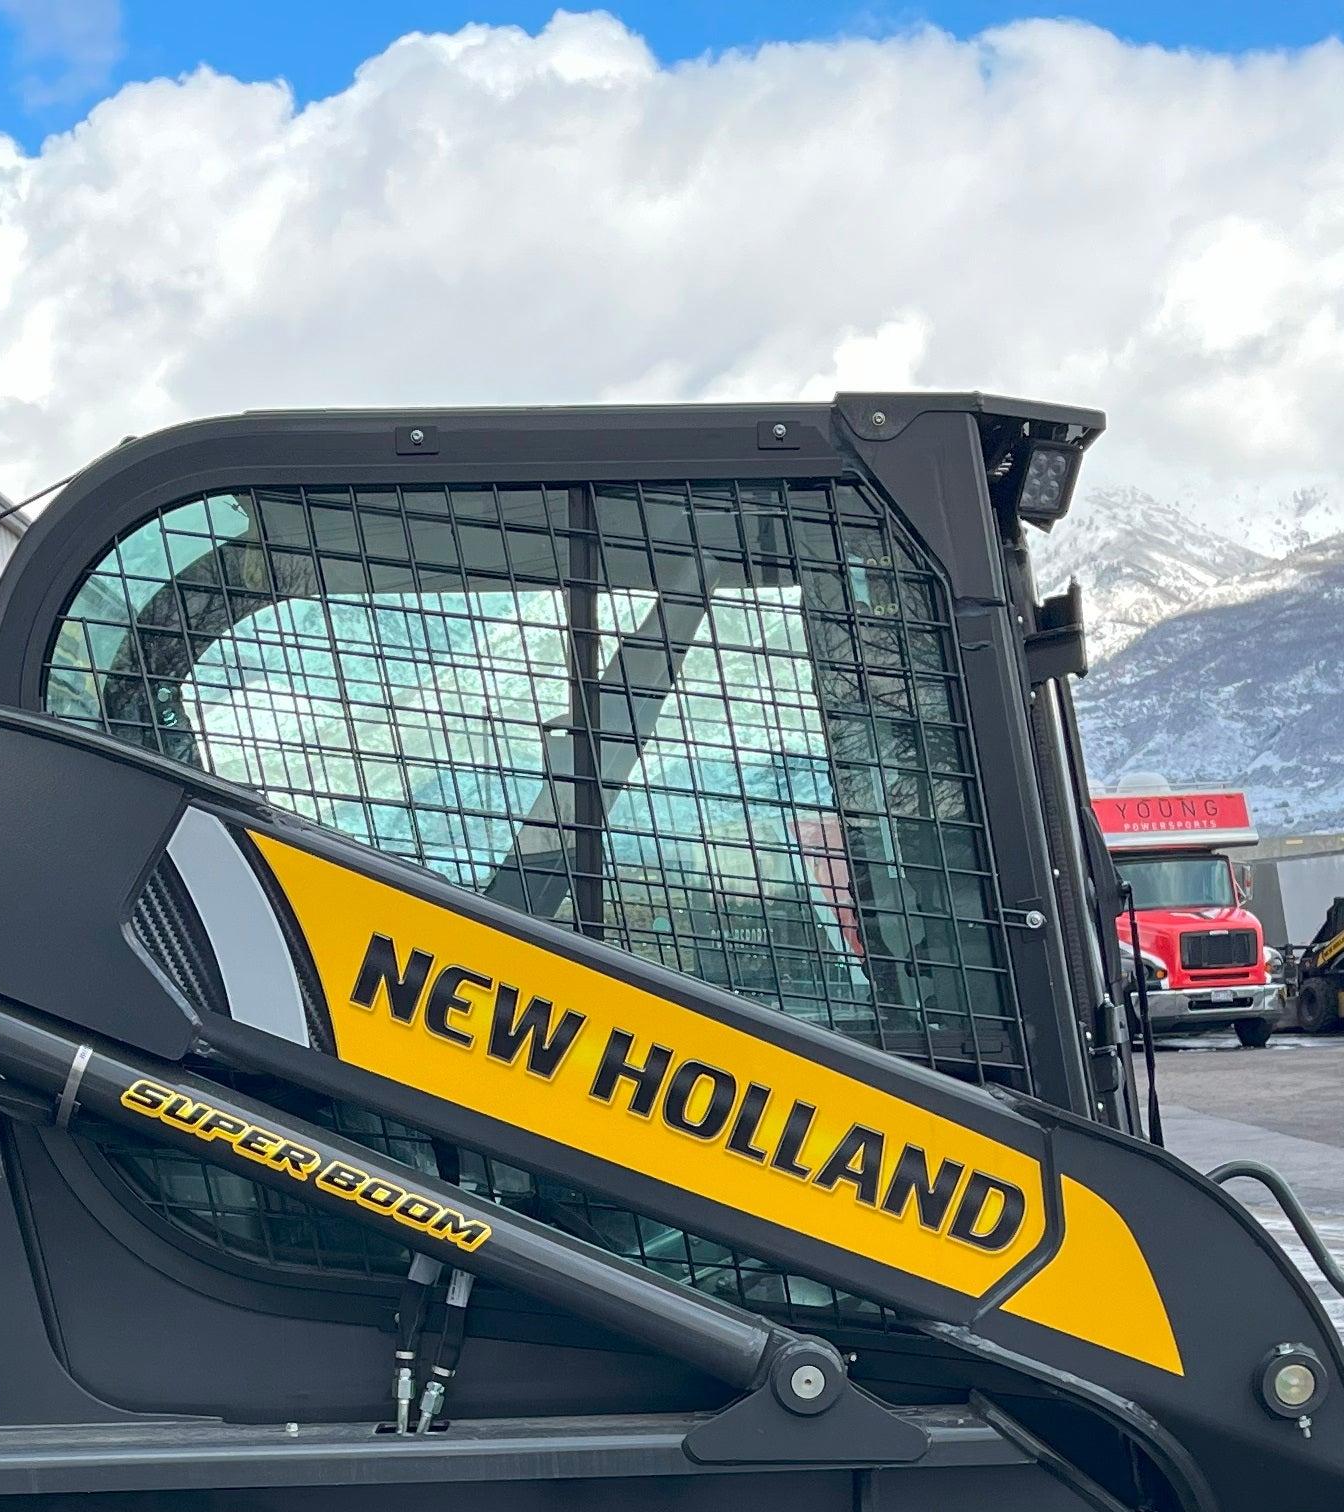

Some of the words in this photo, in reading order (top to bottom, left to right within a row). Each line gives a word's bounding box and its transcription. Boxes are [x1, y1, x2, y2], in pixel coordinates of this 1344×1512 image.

[1115, 799, 1218, 819] YOUNG
[1123, 820, 1218, 831] POWERSPORTS
[350, 929, 588, 1081] NEW
[588, 1026, 1027, 1254] HOLLAND
[121, 1079, 322, 1181] SUPER
[315, 1160, 493, 1253] BOOM
